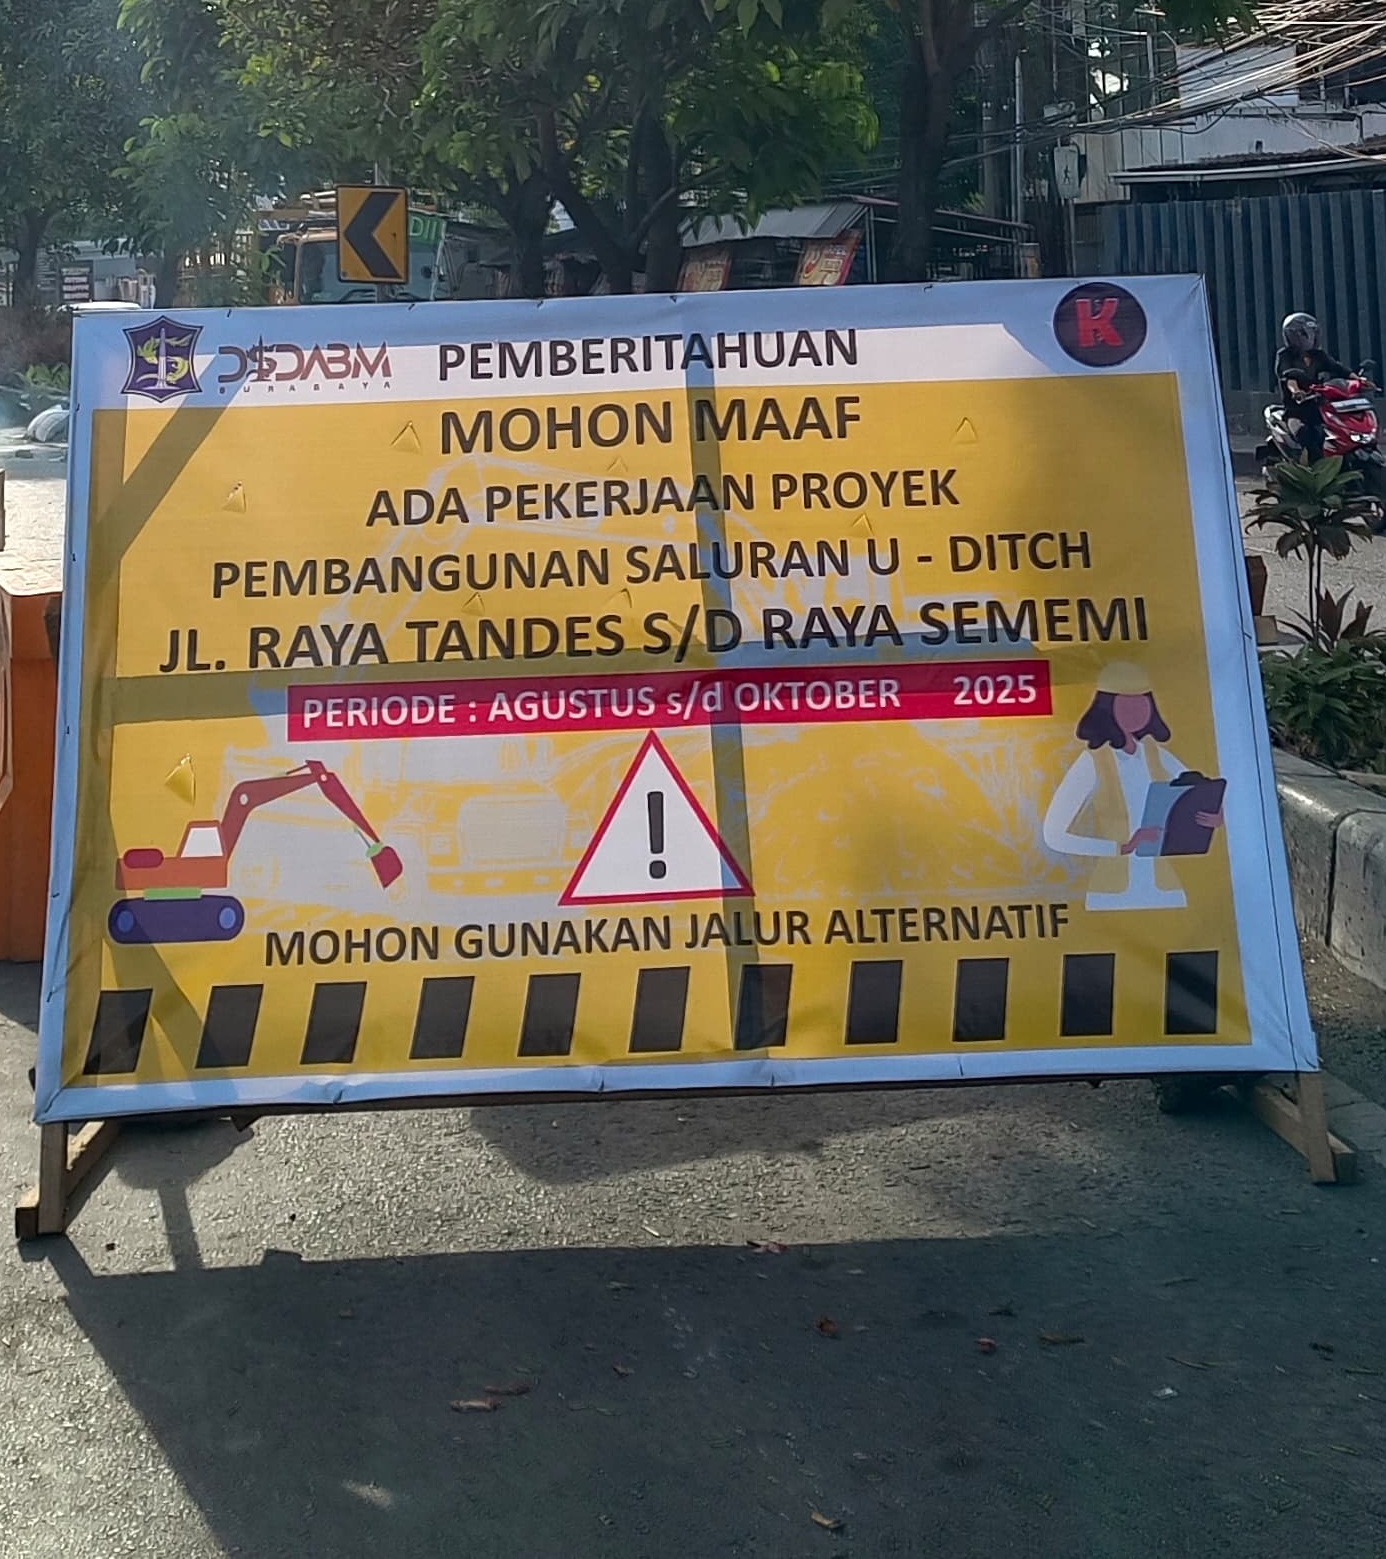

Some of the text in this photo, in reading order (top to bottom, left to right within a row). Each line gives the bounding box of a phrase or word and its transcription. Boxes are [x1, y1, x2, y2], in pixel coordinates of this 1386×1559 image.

[438, 328, 859, 381] PEMBERITAHUAN
[219, 381, 391, 394] SURABAYA
[441, 395, 861, 455] MOHON MAAF
[366, 468, 960, 527] ADA PEKERJAAN PROYEK
[213, 547, 610, 598] PEMBANGUNAN
[626, 539, 850, 584] SALURAN
[867, 538, 899, 575] U
[949, 532, 1092, 574] DITCH
[159, 596, 1149, 673] JL. RAYA TANDES S/D RAYA SEMEMI
[303, 694, 455, 729] PERIODE
[488, 686, 655, 723] AGUSTUS
[667, 682, 723, 721] s/d
[733, 678, 901, 712] OKTOBER
[953, 674, 1037, 706] 2025
[265, 903, 1070, 967] MOHON GUNAKAN JALUR ALTERNATIF
